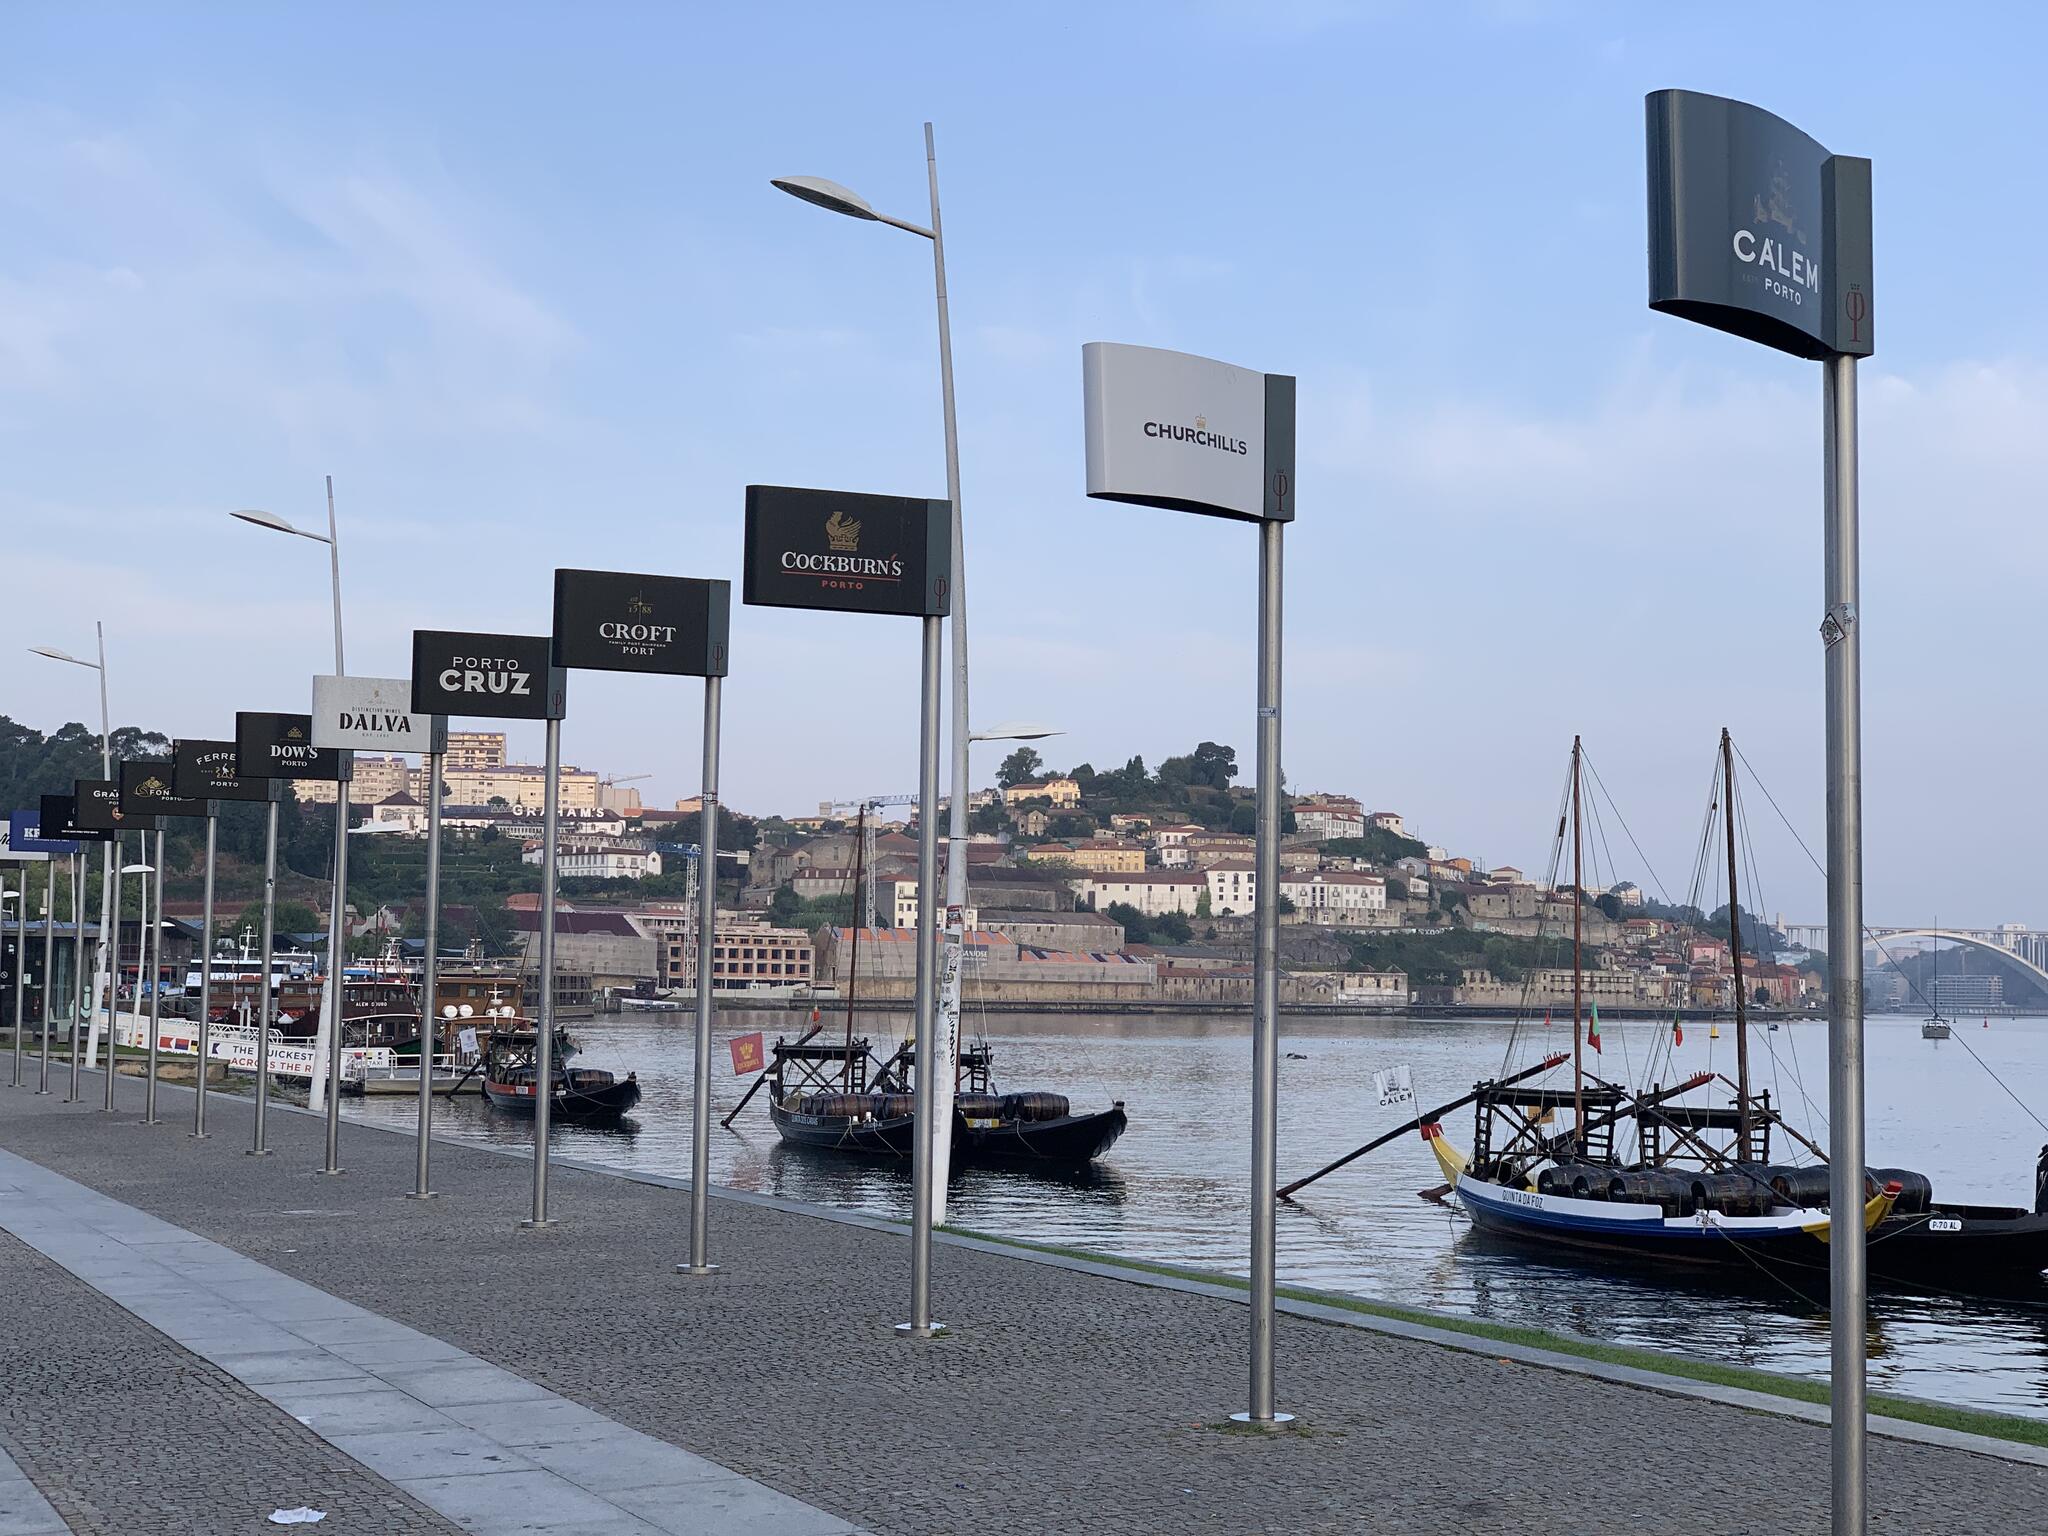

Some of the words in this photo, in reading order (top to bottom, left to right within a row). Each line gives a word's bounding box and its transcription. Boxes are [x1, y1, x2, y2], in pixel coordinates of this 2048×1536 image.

[1764, 277, 1802, 306] PORTO
[781, 551, 902, 576] COCKBURN'S
[821, 580, 864, 590] PORTO
[599, 622, 677, 643] CROFT
[622, 646, 655, 656] PORT
[452, 656, 519, 671] PORTO
[439, 669, 531, 695] CRUZ
[339, 712, 412, 733] DALVA
[196, 752, 237, 766] FERRE
[270, 744, 319, 759] DOW'S
[210, 780, 239, 788] PORTO
[232, 1045, 255, 1055] THE
[267, 1049, 314, 1061] UICKEST
[231, 1057, 276, 1070] ACRS
[280, 1062, 301, 1072] THE
